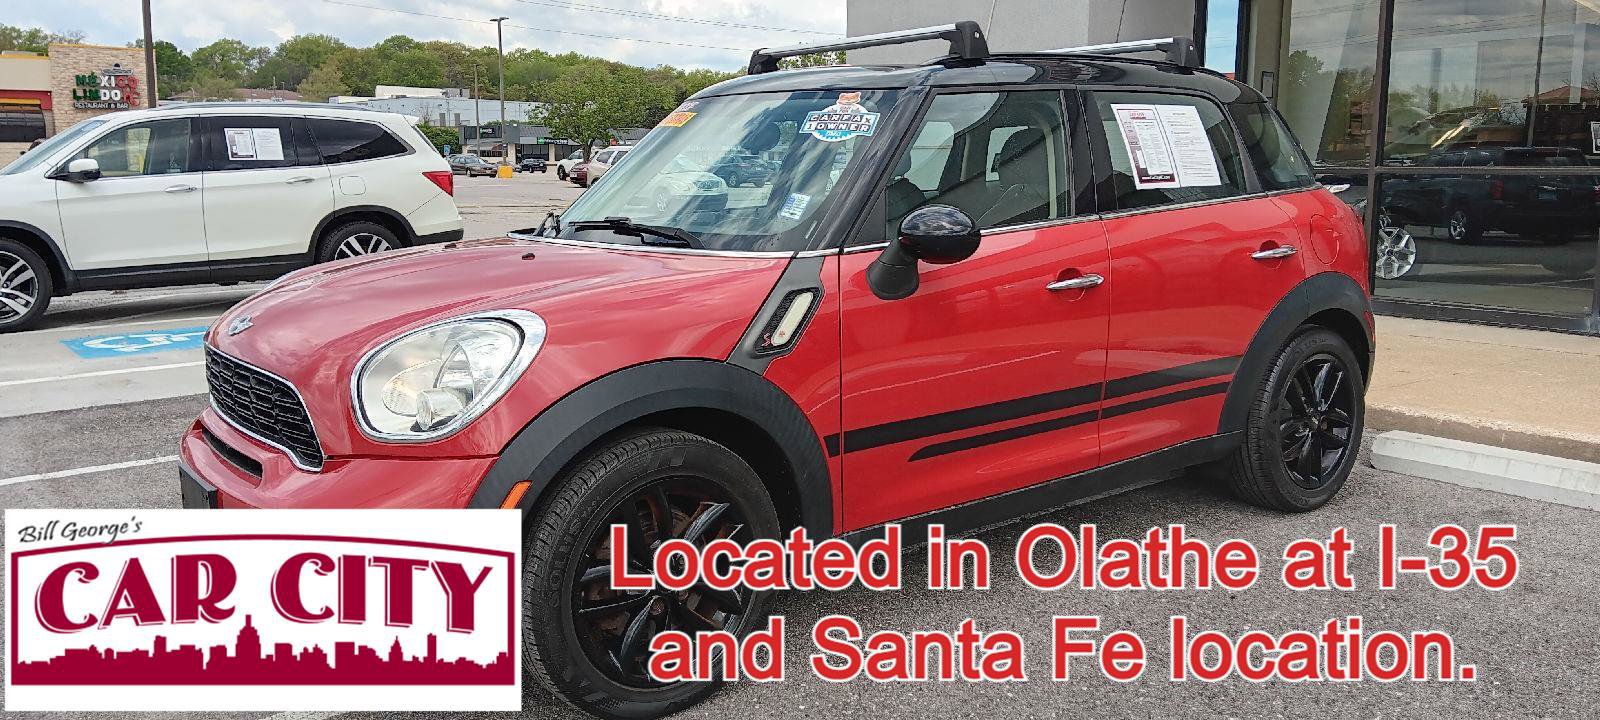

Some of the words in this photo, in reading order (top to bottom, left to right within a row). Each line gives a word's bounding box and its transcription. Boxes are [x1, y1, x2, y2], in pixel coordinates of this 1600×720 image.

[73, 88, 121, 101] LINDO
[74, 101, 108, 109] RESTAURANT
[810, 113, 872, 124] CARFAX
[816, 122, 870, 132] OWNER
